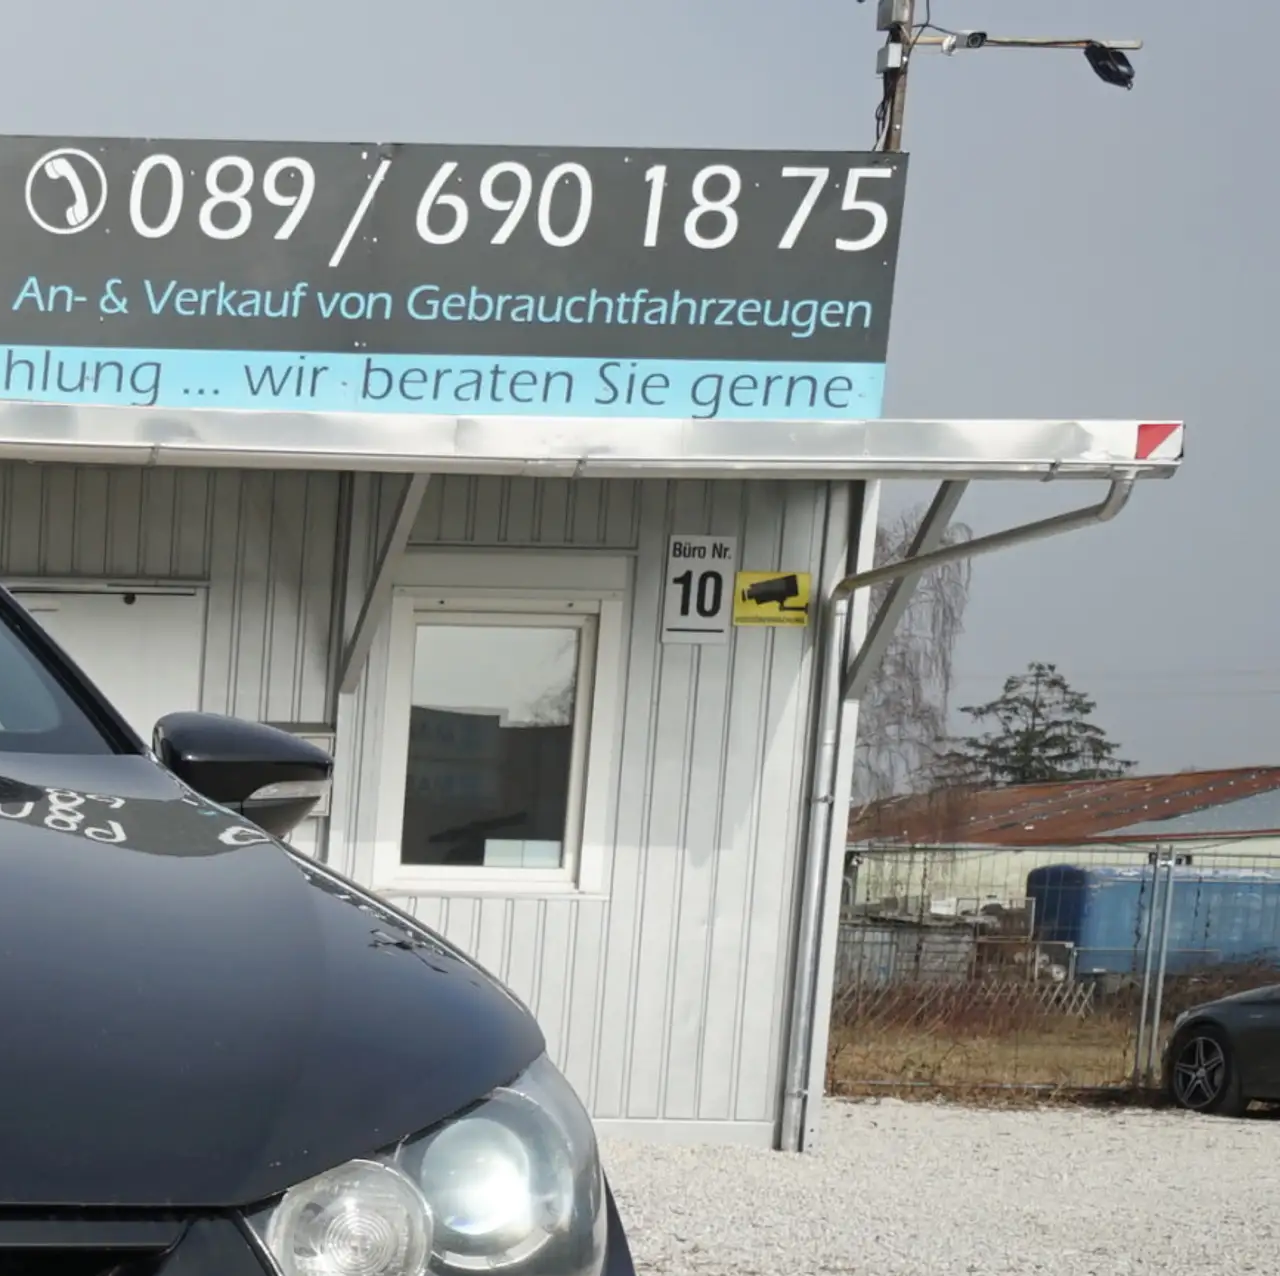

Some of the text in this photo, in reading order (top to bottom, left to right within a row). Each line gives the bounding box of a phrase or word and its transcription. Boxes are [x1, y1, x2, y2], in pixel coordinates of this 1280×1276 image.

[129, 154, 316, 243] 089
[416, 160, 593, 249] 690
[642, 163, 742, 249] 18
[778, 166, 893, 252] 75
[12, 276, 874, 338] An- & Verkauf von Gebrauchtfahrzeugen
[244, 358, 329, 398] wir
[361, 356, 574, 405] beraten
[593, 361, 670, 406] Sie
[691, 370, 853, 419] gerne
[672, 542, 732, 559] Büro Nr.
[673, 570, 723, 618] 10
